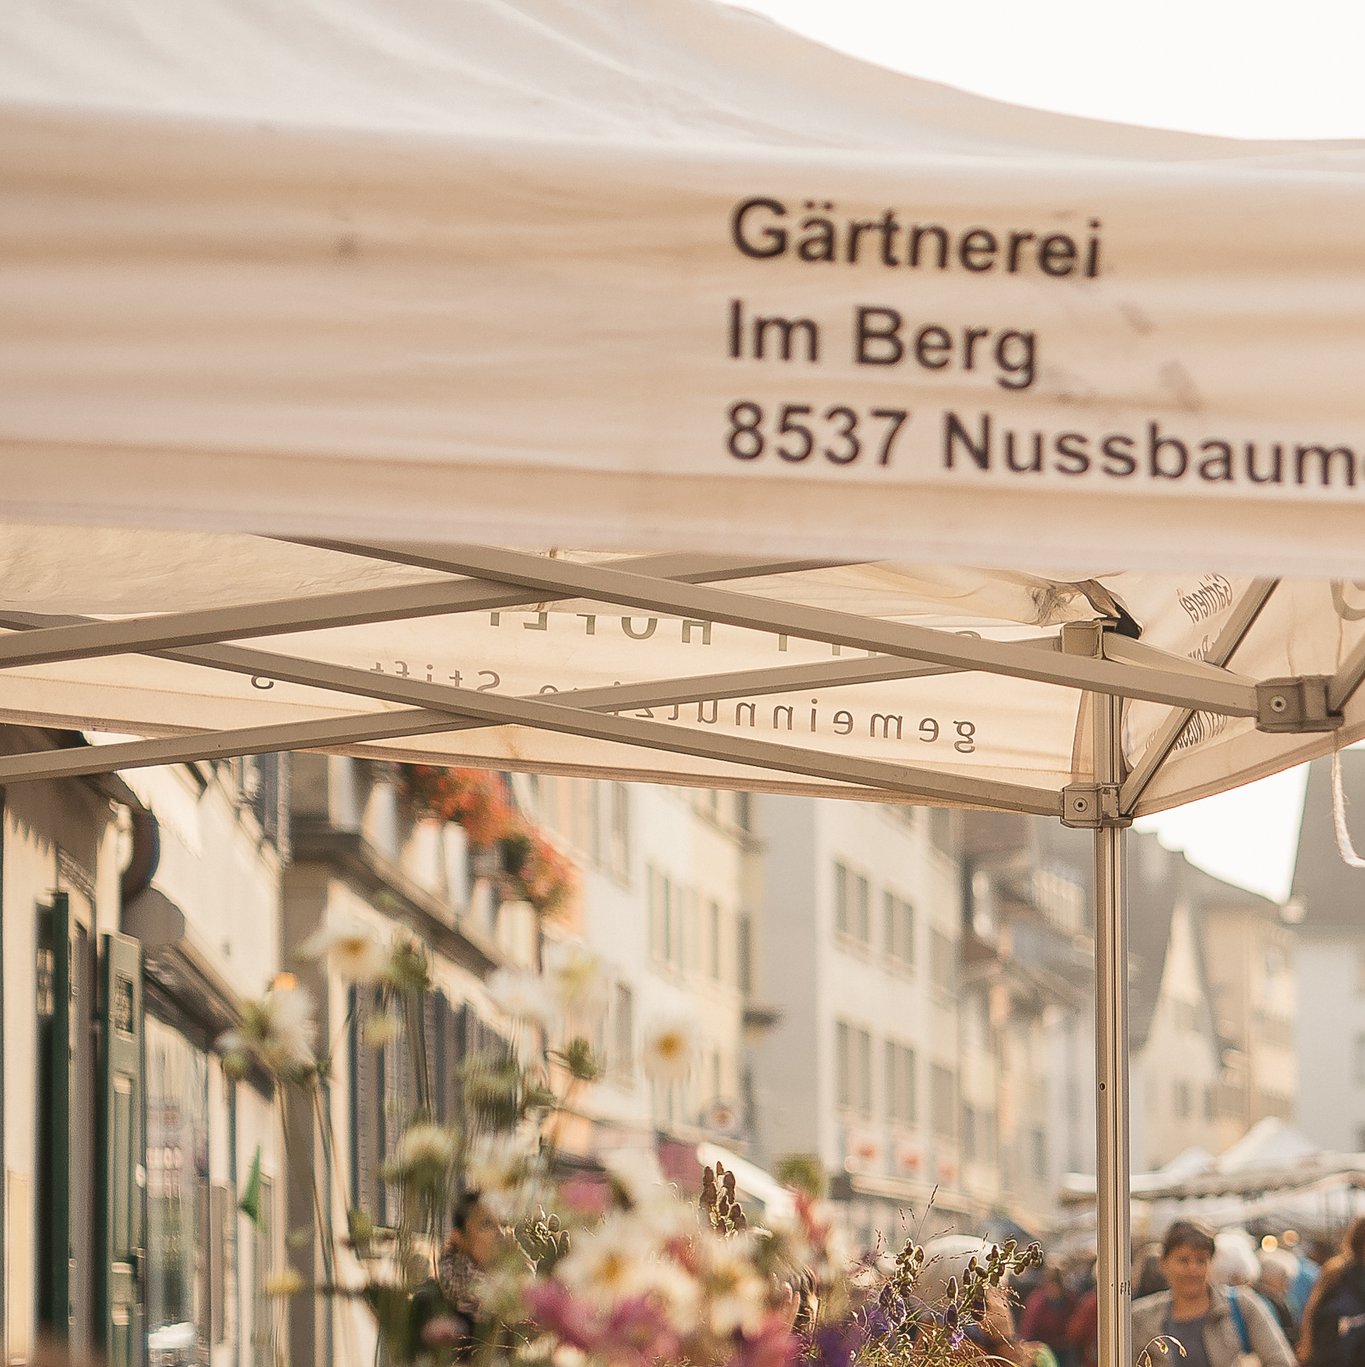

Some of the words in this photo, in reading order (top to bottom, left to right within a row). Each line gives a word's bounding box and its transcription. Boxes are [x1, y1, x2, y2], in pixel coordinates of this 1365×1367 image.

[730, 196, 1103, 280] Gärtnerei
[727, 299, 821, 364] Im
[853, 306, 1040, 389] Berg
[726, 402, 909, 467] 8537
